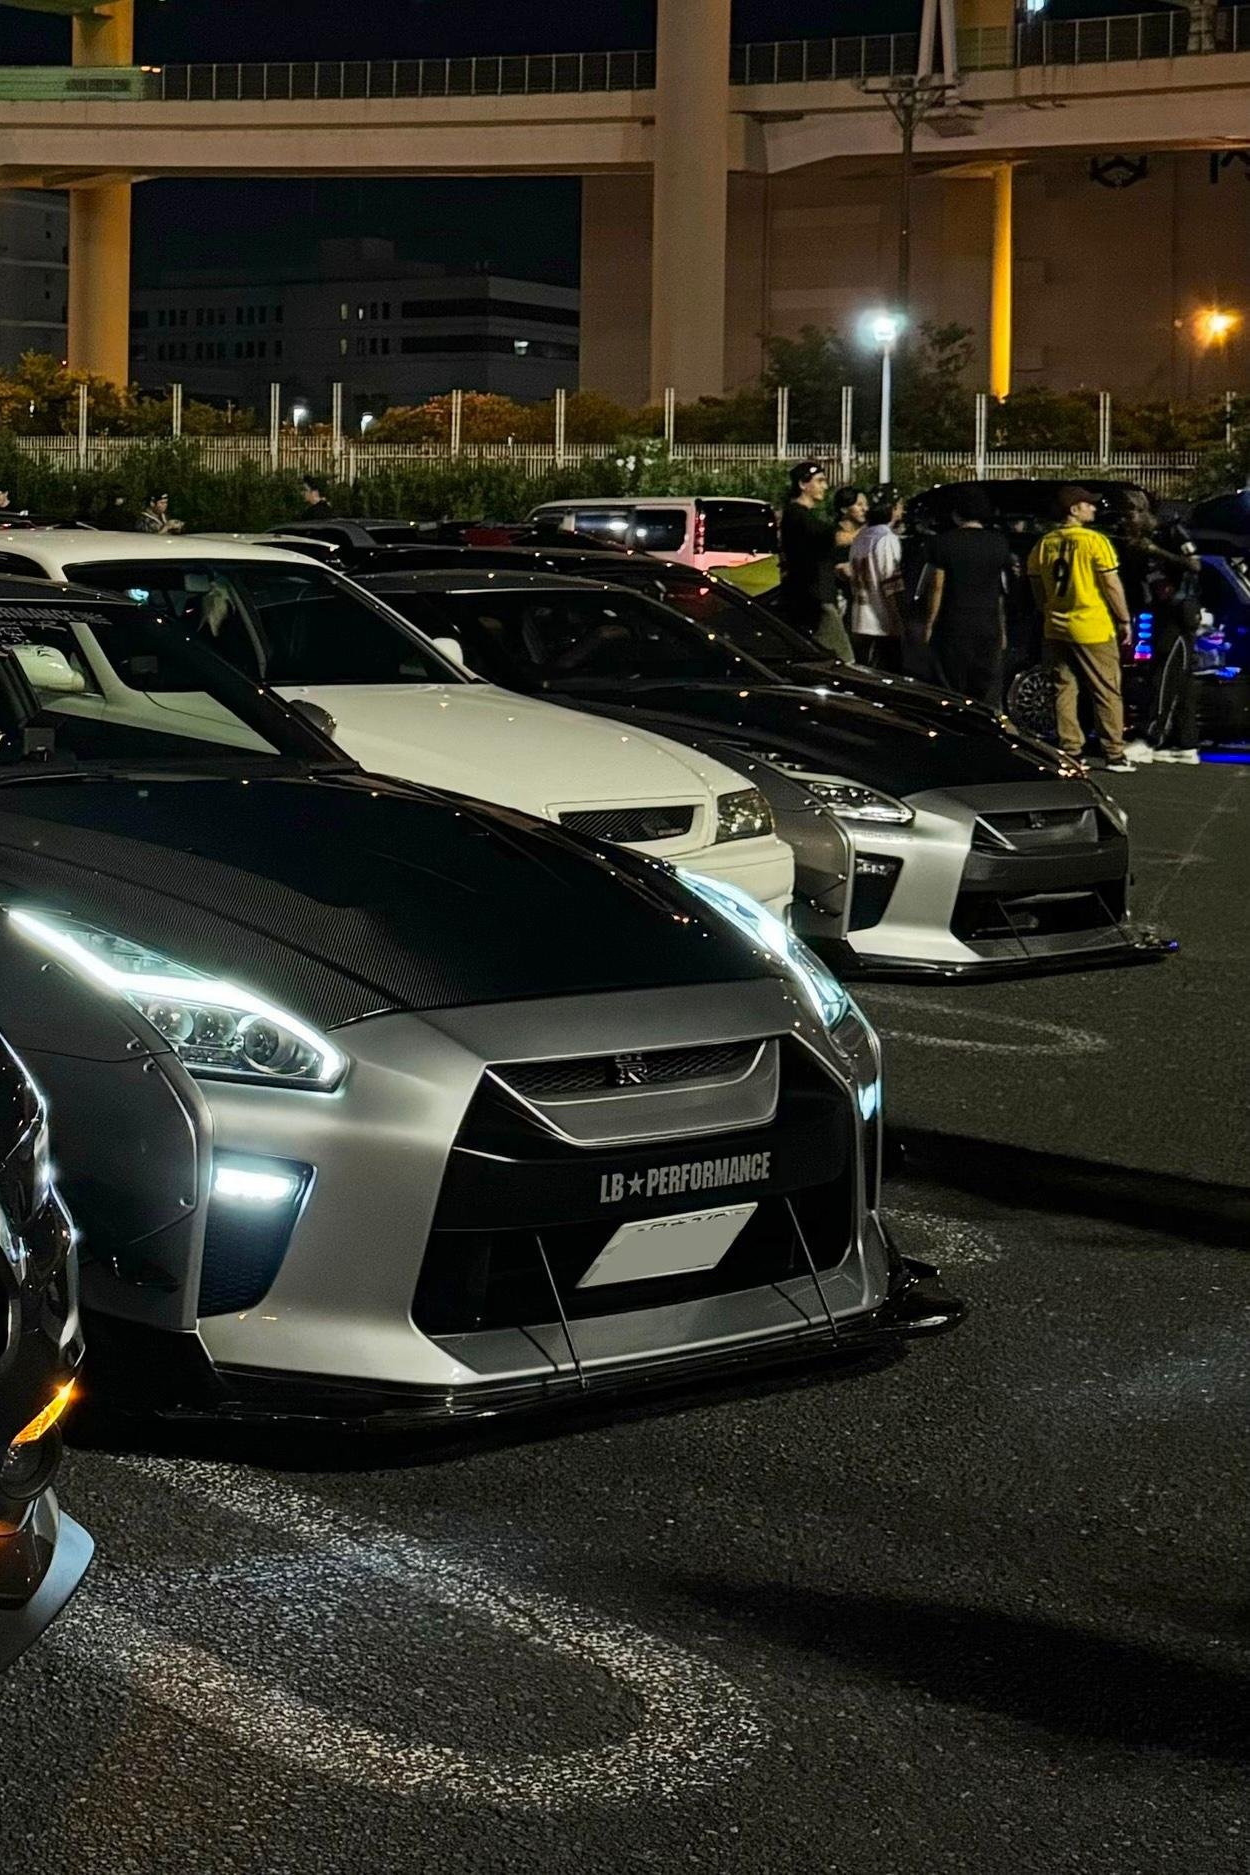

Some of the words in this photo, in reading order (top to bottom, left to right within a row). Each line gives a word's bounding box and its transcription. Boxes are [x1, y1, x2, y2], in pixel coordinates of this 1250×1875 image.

[1053, 557, 1070, 597] 9
[599, 1172, 625, 1204] LB
[645, 1151, 772, 1198] PERFORMANCE
